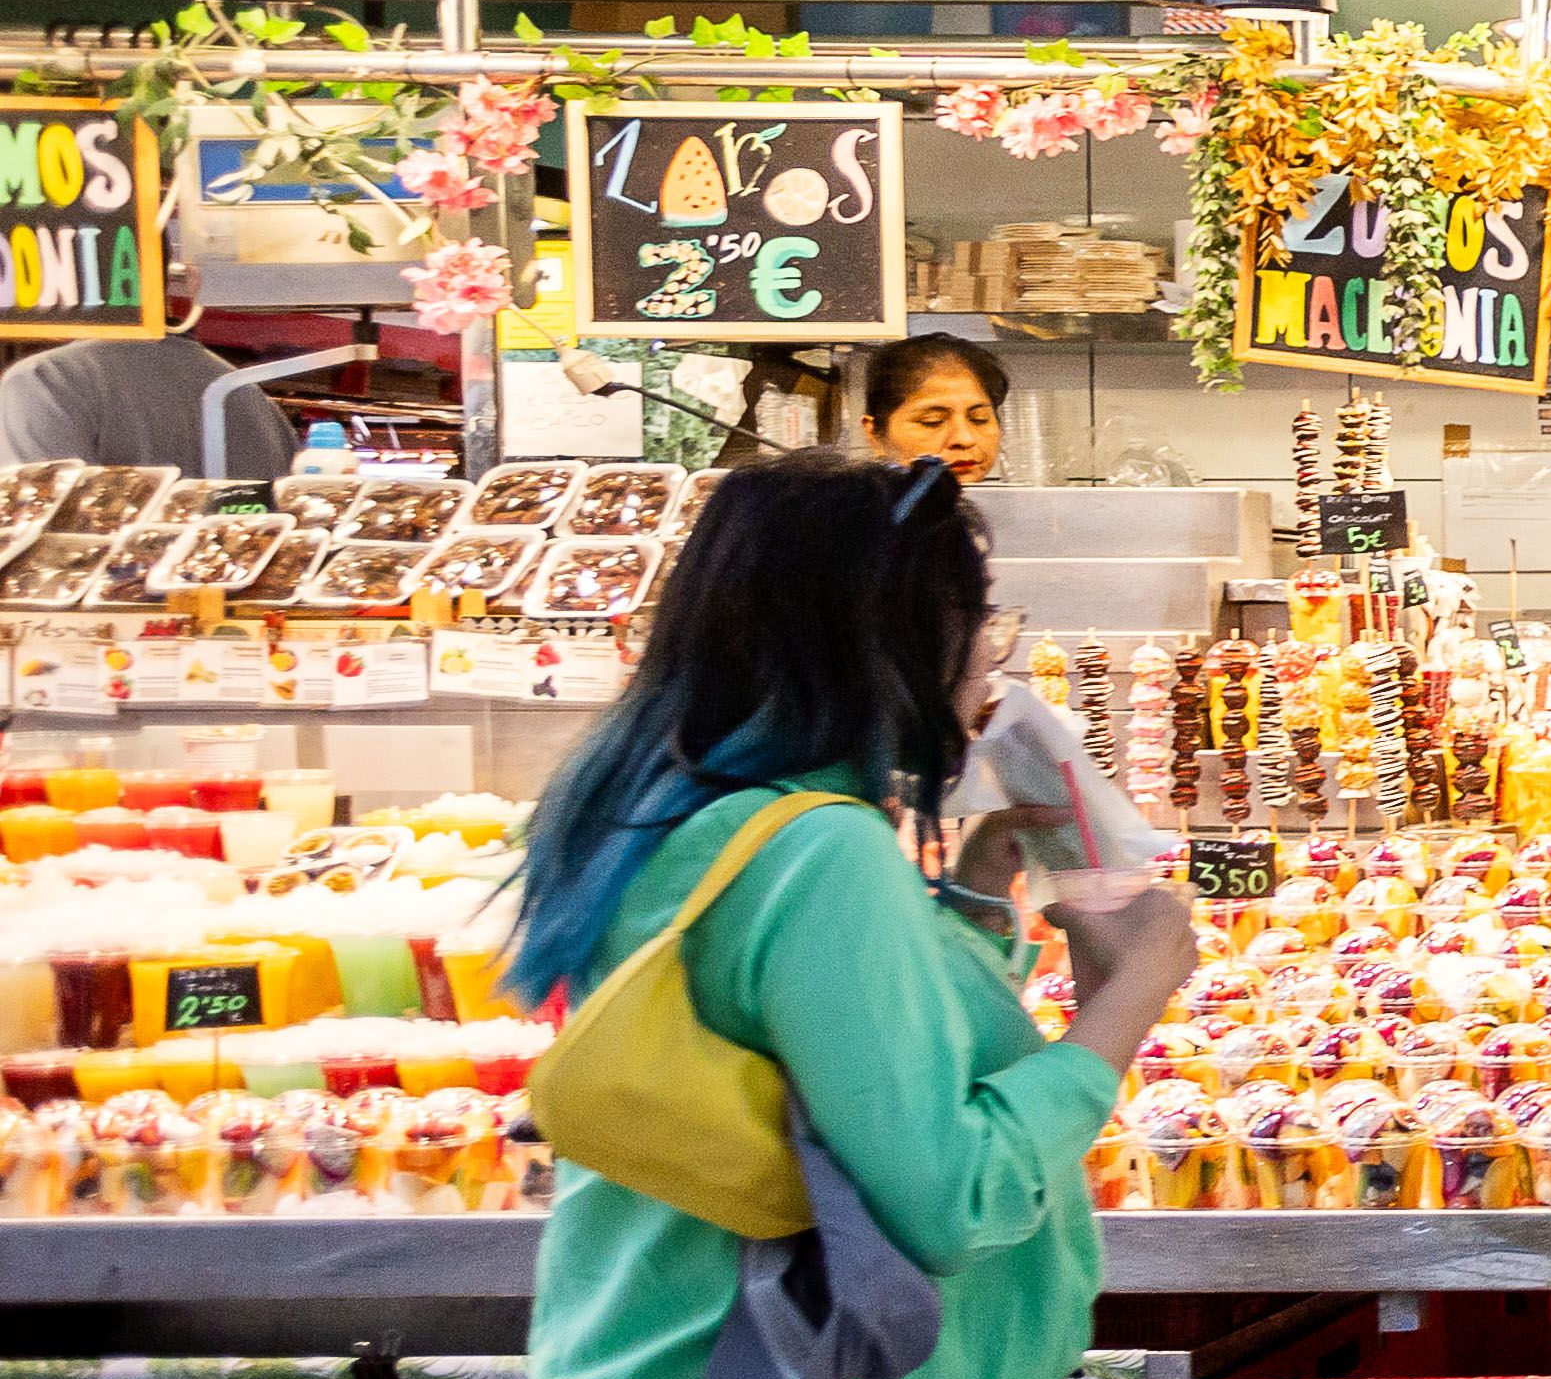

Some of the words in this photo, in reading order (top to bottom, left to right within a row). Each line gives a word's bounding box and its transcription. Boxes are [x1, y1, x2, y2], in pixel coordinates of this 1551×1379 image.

[1347, 525, 1388, 553] 5€
[1194, 861, 1269, 896] 3'50
[174, 994, 249, 1027] 2'50
